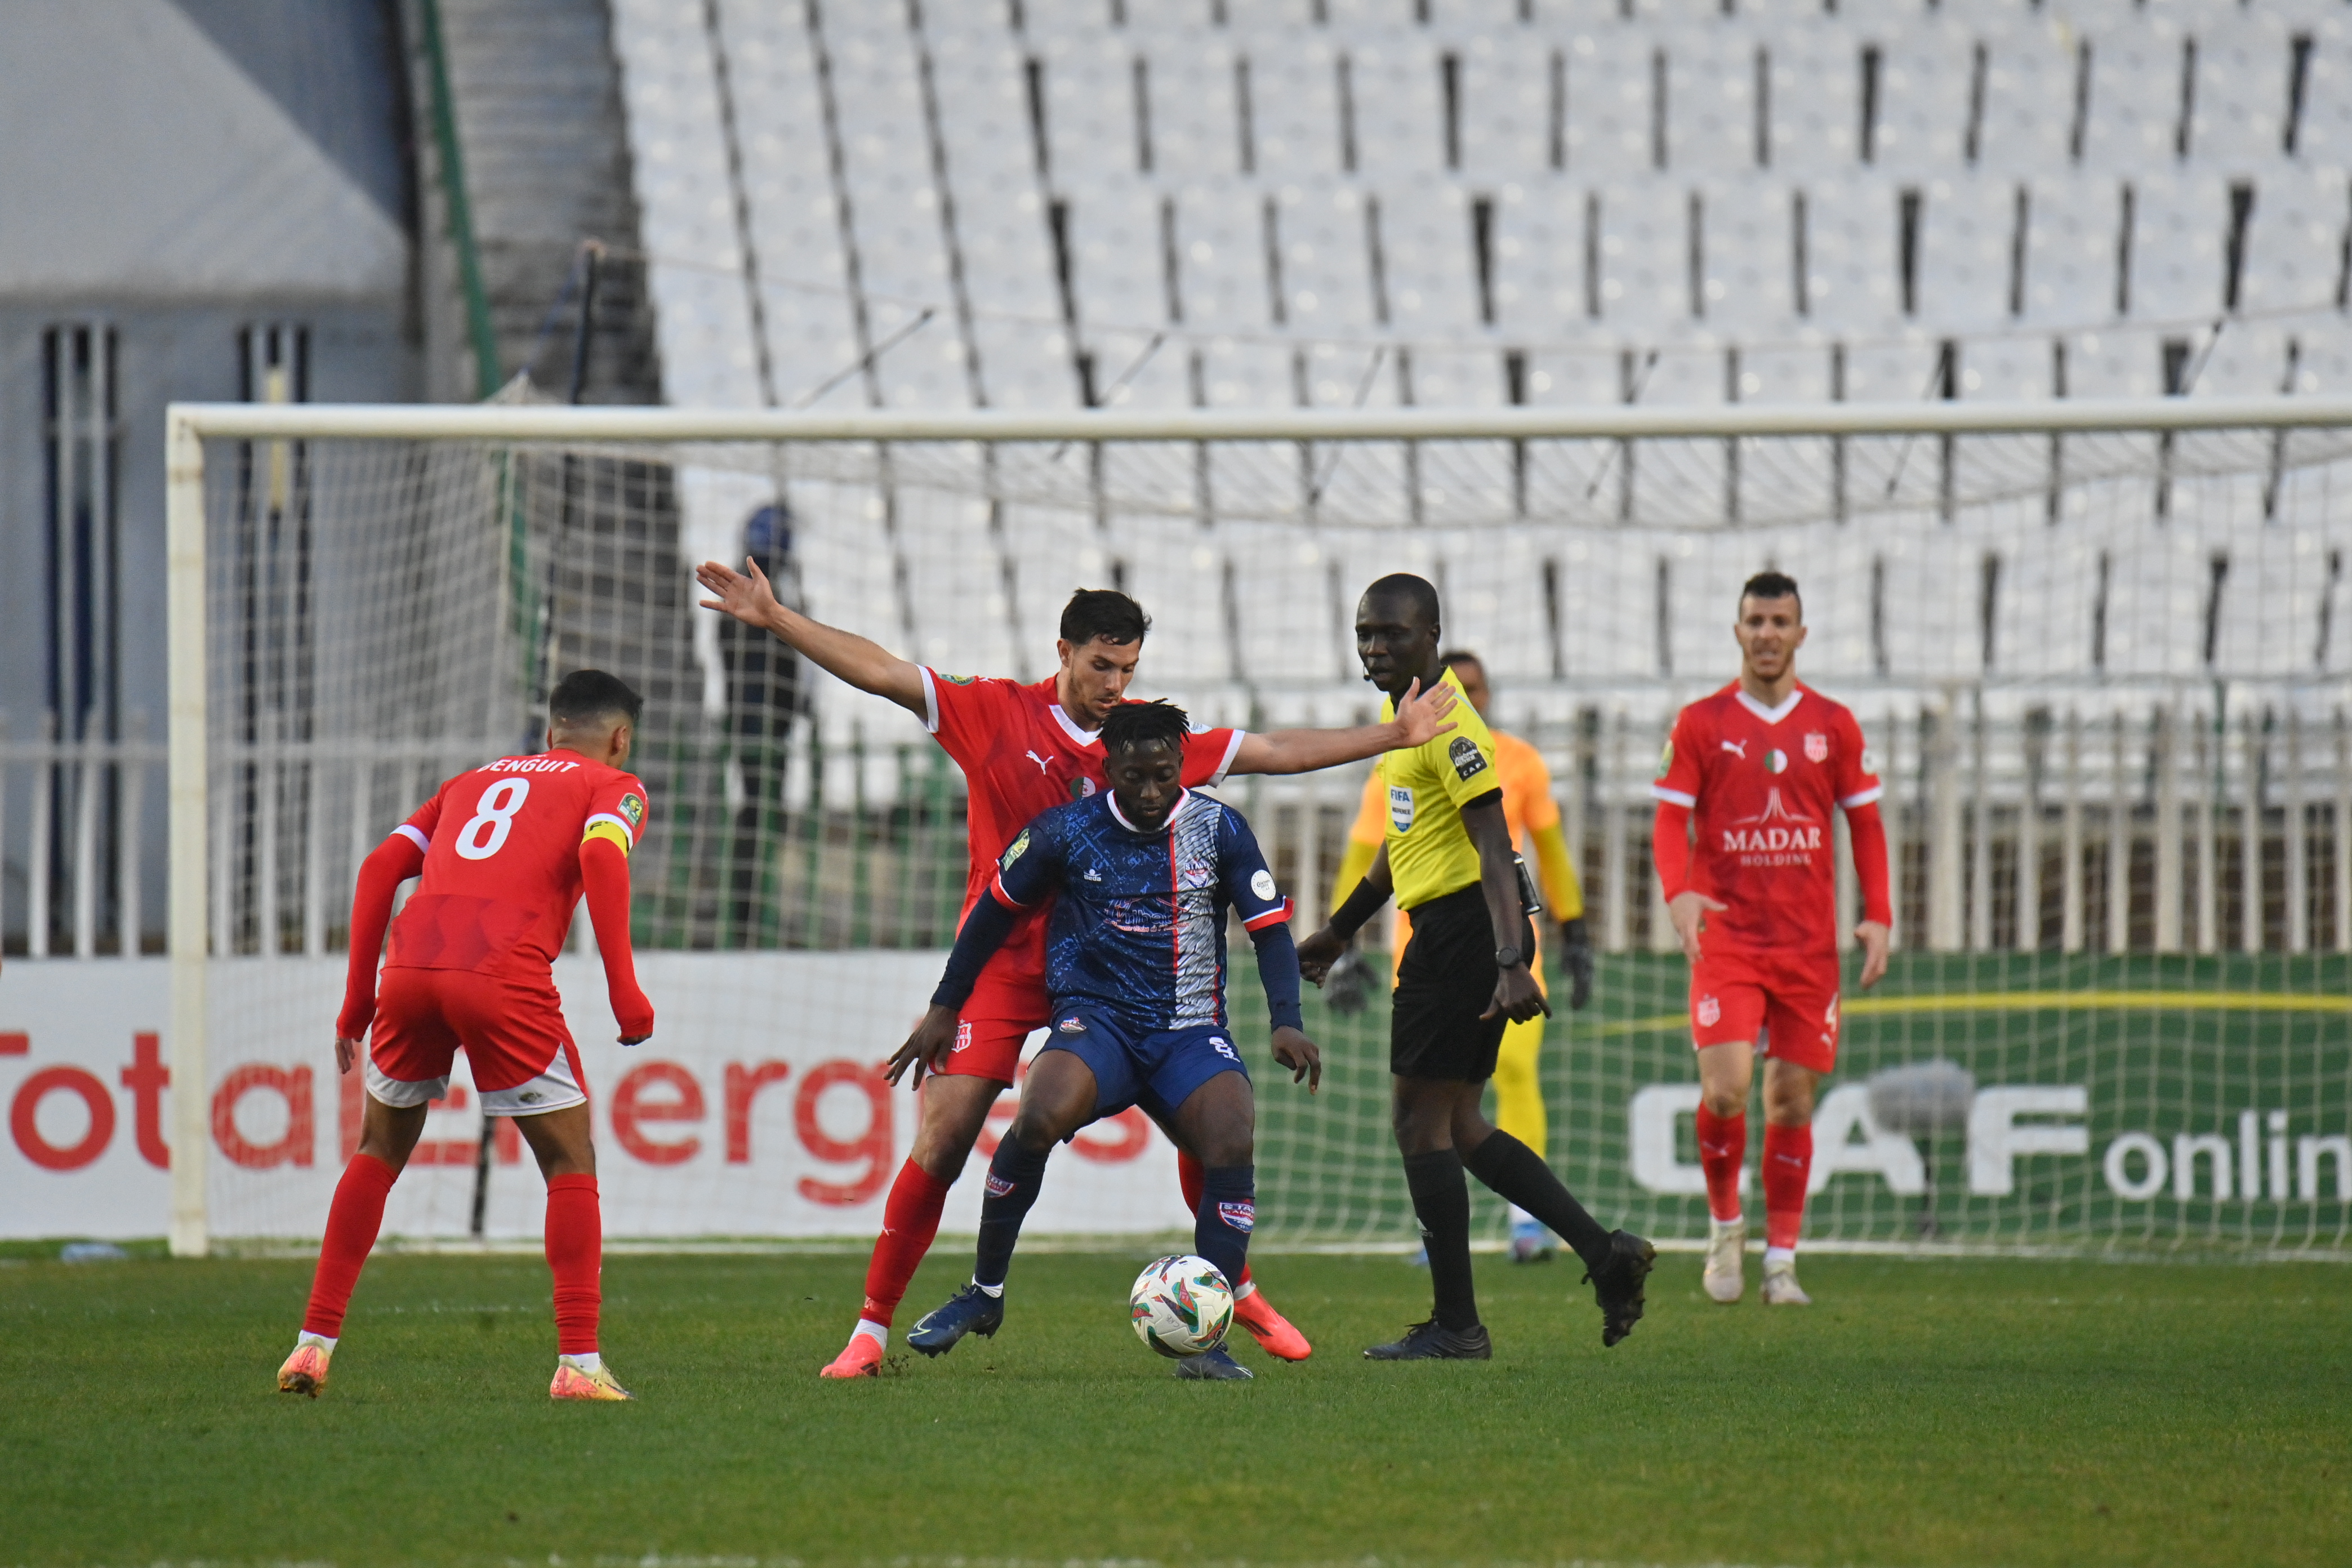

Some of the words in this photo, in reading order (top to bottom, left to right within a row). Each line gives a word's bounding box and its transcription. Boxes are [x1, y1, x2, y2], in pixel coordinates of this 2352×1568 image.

[1391, 789, 1410, 801] FIFA
[455, 777, 530, 860] 8
[1723, 827, 1821, 852] MADAR
